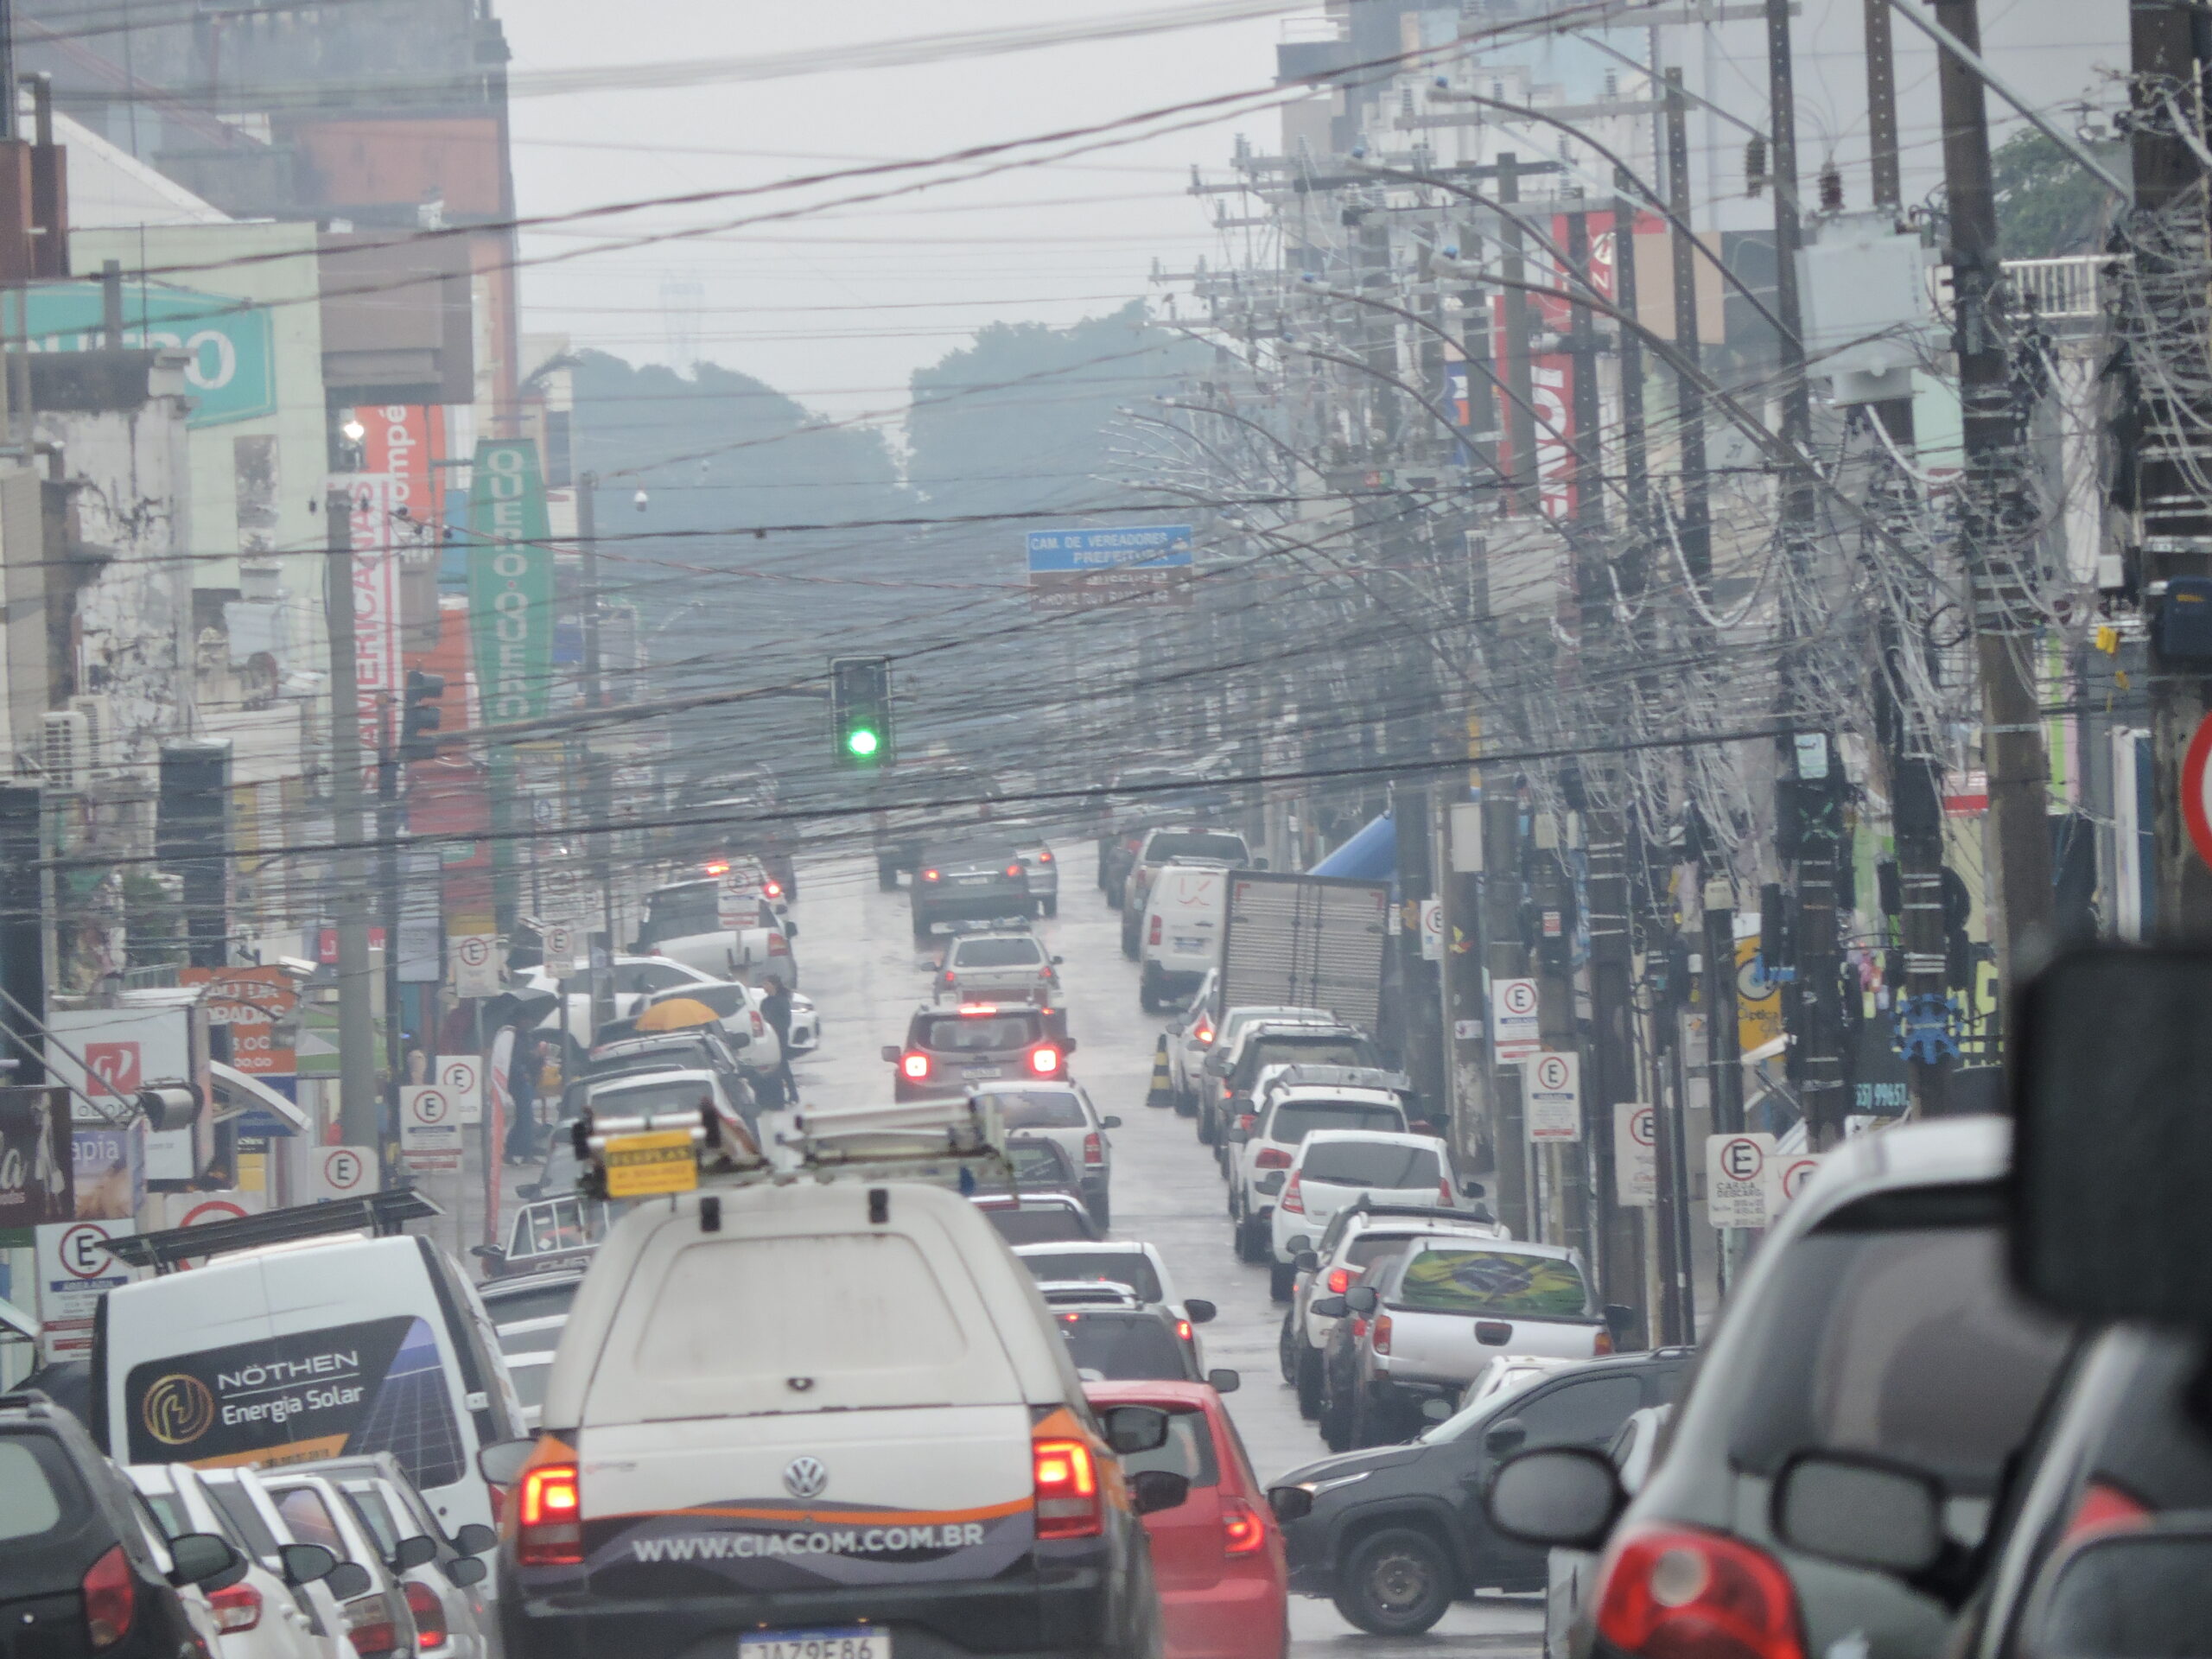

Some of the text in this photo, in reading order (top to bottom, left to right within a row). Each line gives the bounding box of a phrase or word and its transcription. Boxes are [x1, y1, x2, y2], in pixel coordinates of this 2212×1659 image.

[1065, 536, 1082, 549] DE
[1088, 531, 1169, 547] VEREADORES
[1515, 989, 1526, 1007] E
[454, 1069, 465, 1088] E
[1548, 1064, 1558, 1084] E
[424, 1097, 435, 1117] E
[71, 1135, 119, 1161] apia
[1732, 1145, 1752, 1174] E
[337, 1159, 350, 1181] E
[76, 1234, 97, 1267] E
[218, 1350, 359, 1390] NÖTHEN
[221, 1384, 365, 1426] Energia Solar
[632, 1522, 985, 1562] WWW.CIACOM.COM.BR
